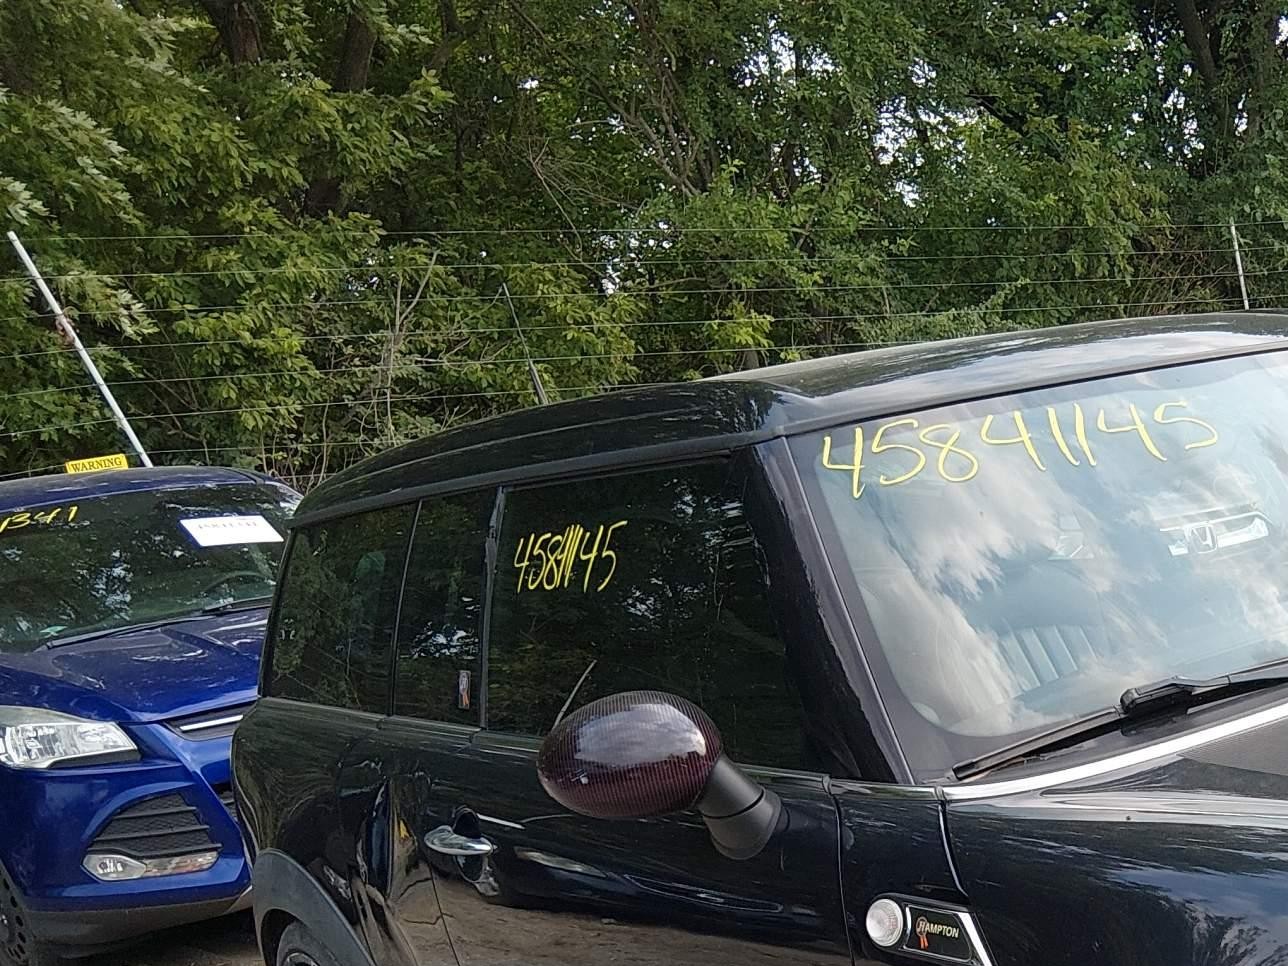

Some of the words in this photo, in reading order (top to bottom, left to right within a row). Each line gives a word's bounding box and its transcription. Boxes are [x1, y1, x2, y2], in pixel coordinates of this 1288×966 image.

[823, 401, 1219, 498] 45841145
[71, 457, 122, 472] WARNING
[917, 920, 960, 938] HAMPTON
